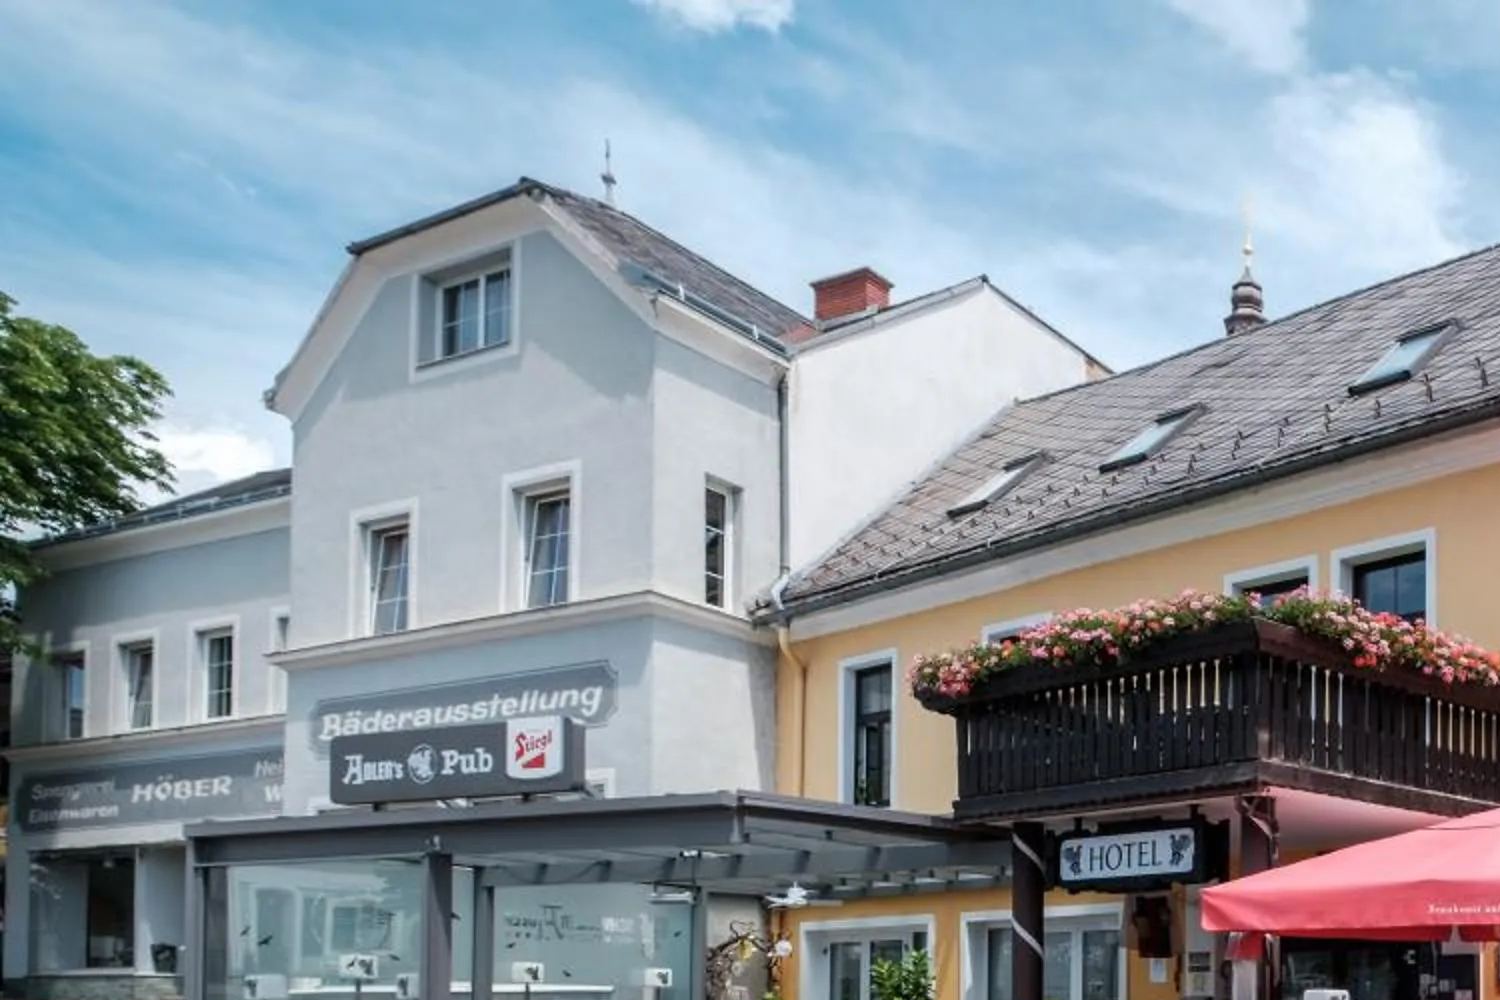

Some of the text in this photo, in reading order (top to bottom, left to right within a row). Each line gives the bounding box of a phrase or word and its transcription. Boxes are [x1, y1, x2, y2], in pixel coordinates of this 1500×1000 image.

[319, 685, 603, 740] Bäderausstellung
[441, 748, 493, 775] Pub
[131, 775, 233, 804] HÖBER
[1089, 839, 1162, 872] HOTEL
